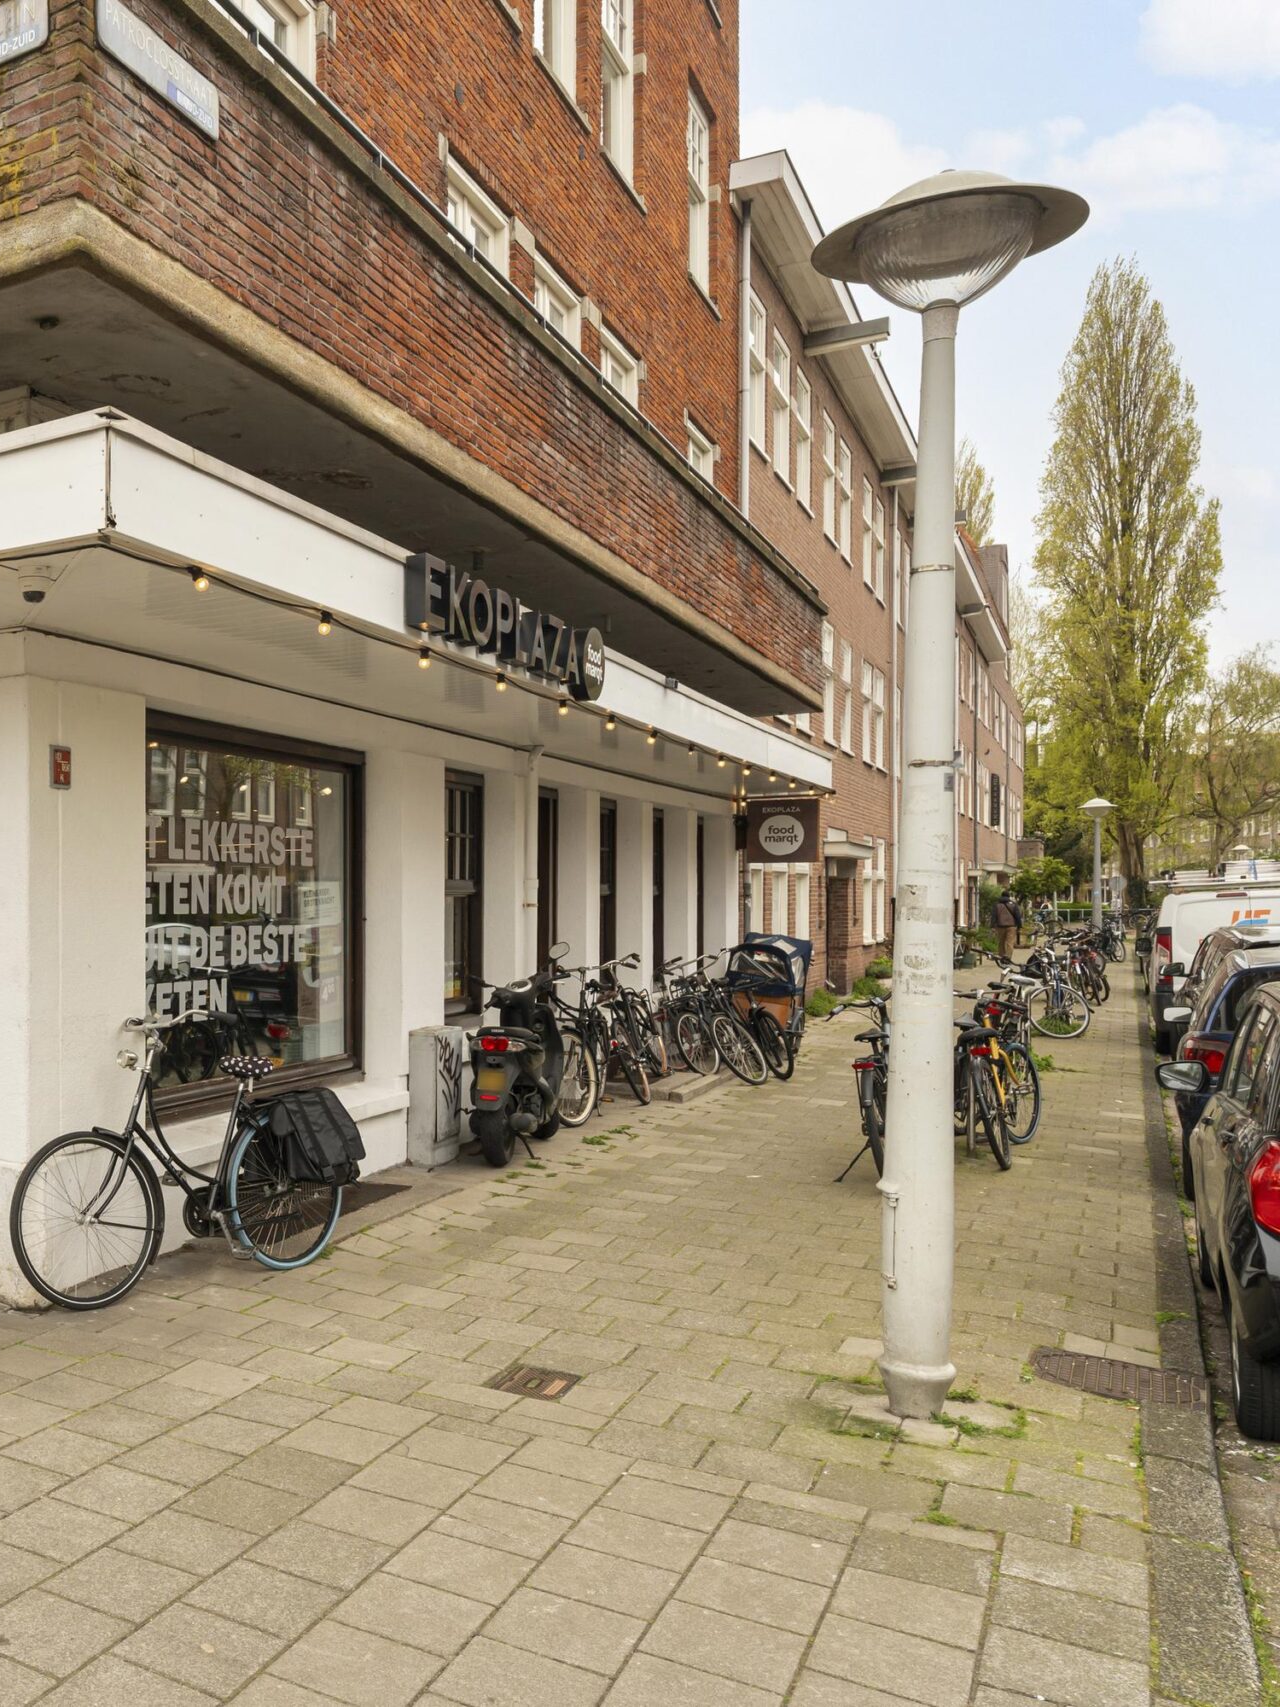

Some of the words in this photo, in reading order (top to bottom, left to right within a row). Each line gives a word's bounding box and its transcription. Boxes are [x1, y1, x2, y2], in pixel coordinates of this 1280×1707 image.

[420, 552, 580, 686] EKOPLAZA
[587, 643, 602, 665] food
[585, 662, 603, 685] marqt
[762, 806, 801, 814] EKOPLAZA
[168, 816, 314, 867] LEKKERSTE
[764, 835, 799, 845] marqt
[767, 825, 795, 835] food
[216, 873, 286, 915] KOMT
[190, 926, 225, 968] DE
[231, 924, 308, 966] BESTE
